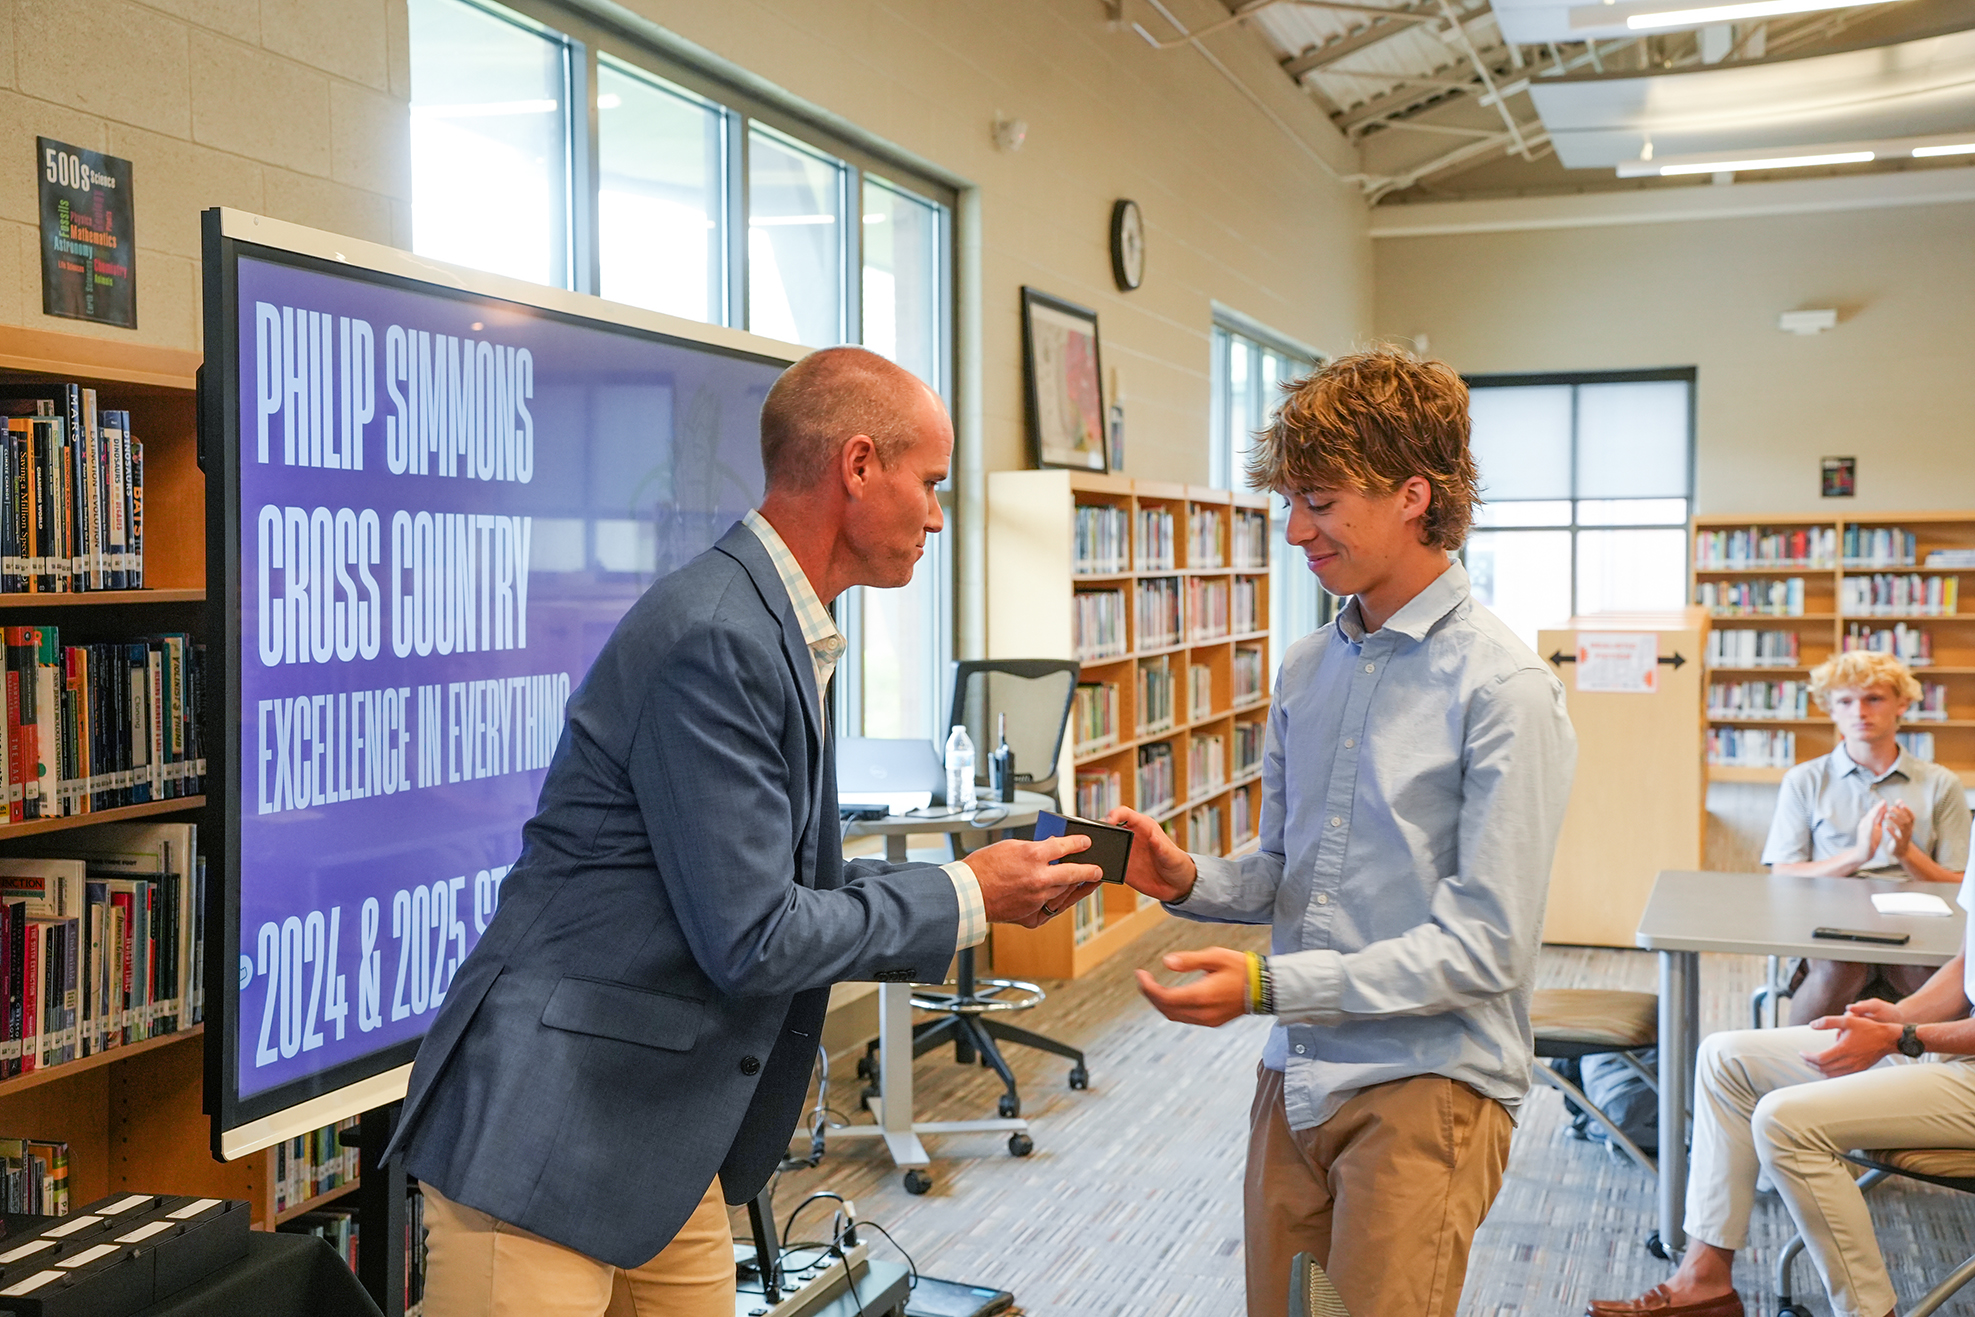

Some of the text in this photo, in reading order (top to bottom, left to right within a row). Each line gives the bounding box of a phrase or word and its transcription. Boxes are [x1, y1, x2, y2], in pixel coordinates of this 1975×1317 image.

[91, 169, 116, 189] Science
[58, 199, 70, 238] Fossils
[70, 224, 117, 249] Mathematics
[53, 235, 93, 260] Astronomy
[93, 257, 128, 279] Chemistry
[255, 301, 535, 484] PHILIP SIMMONS
[70, 394, 80, 442] MARS
[18, 451, 27, 482] Saving
[113, 438, 121, 484] DINOSAURS
[123, 430, 133, 497] DINOSAURS
[20, 492, 29, 529] Million
[133, 486, 143, 537] BATS
[20, 531, 29, 558] Speci
[257, 504, 533, 668] CROSS COUNTRY
[173, 714, 182, 748] THUMB
[257, 686, 411, 816] EXCELLENCE
[417, 684, 442, 788] IN
[255, 906, 349, 1068] 2024
[357, 896, 382, 1033] &
[391, 875, 467, 1022] 2025
